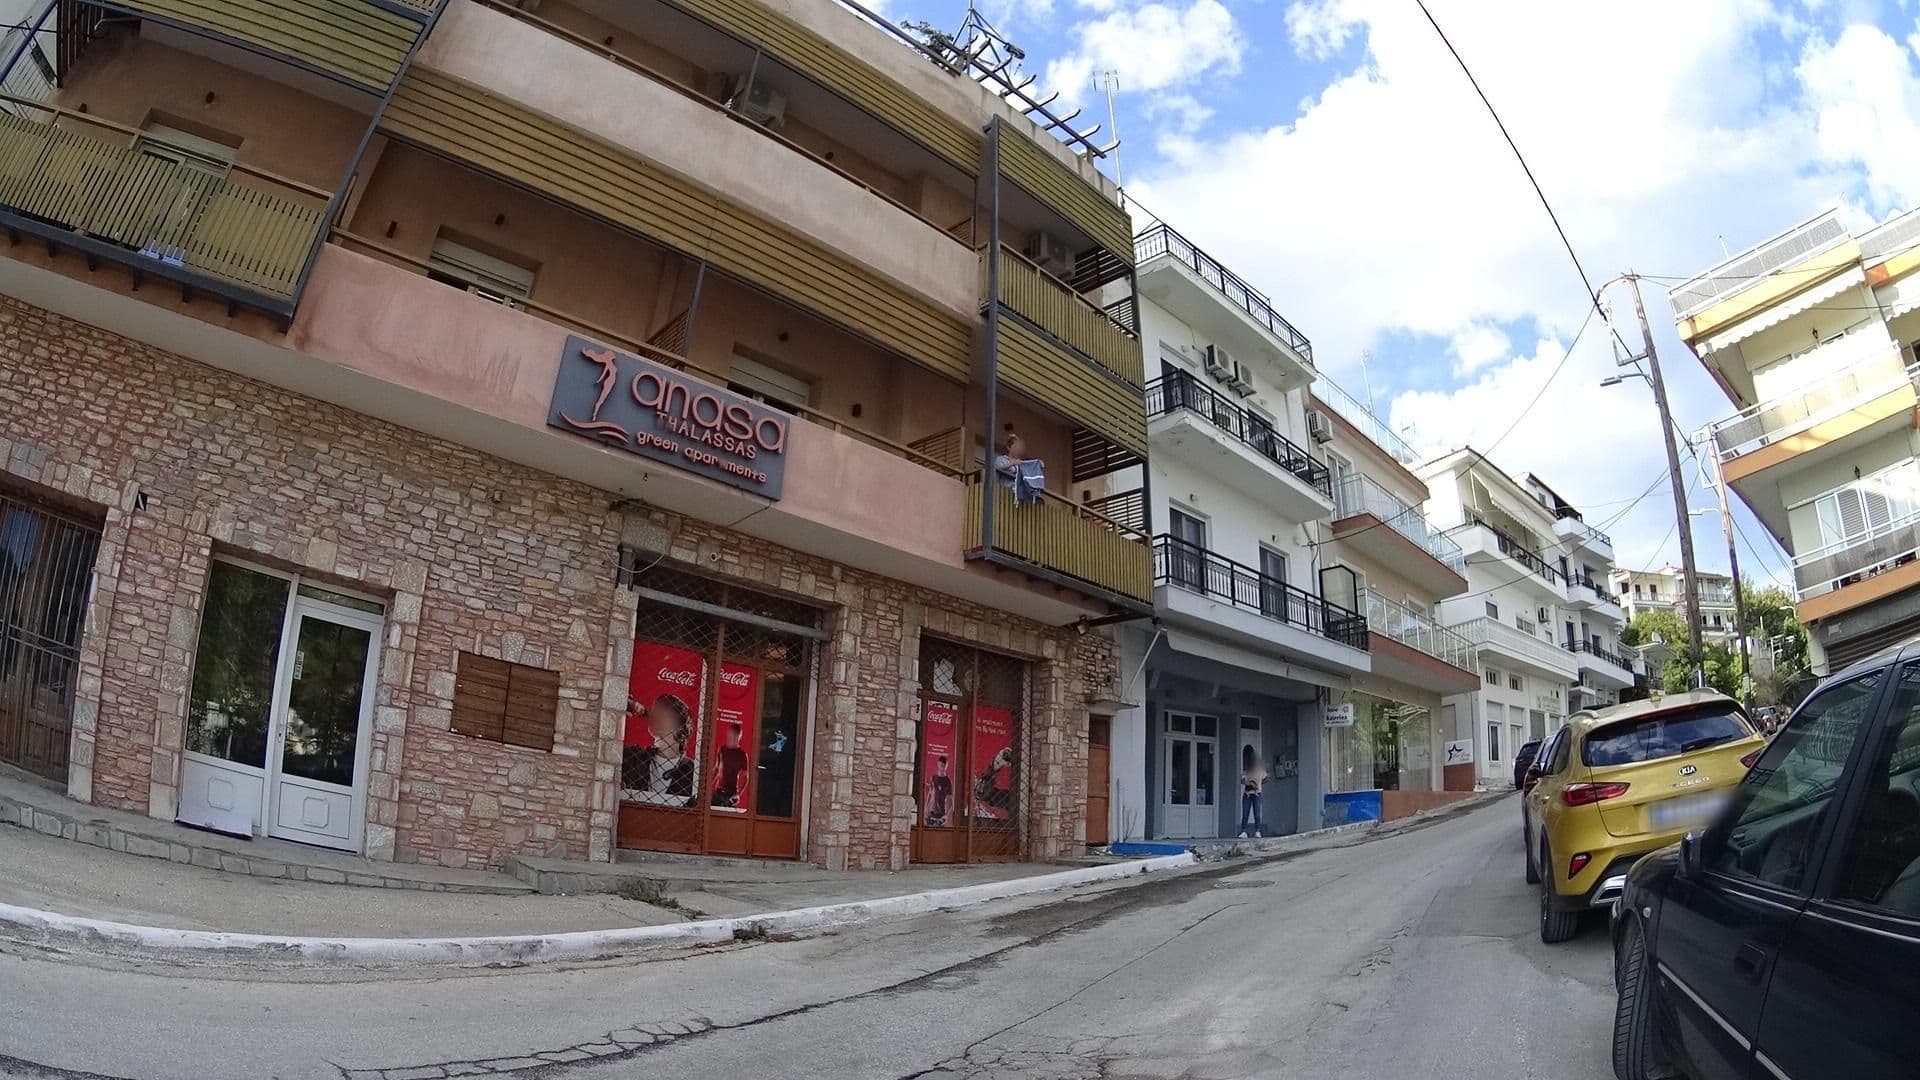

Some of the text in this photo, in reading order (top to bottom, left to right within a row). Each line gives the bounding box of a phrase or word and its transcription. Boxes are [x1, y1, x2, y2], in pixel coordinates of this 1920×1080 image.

[631, 370, 785, 454] anasa
[655, 410, 757, 459] THALASSAS
[636, 430, 768, 483] green aparments
[657, 667, 697, 686] Coca-Cola
[927, 710, 952, 725] Coca-Cola
[1682, 766, 1696, 775] KIA
